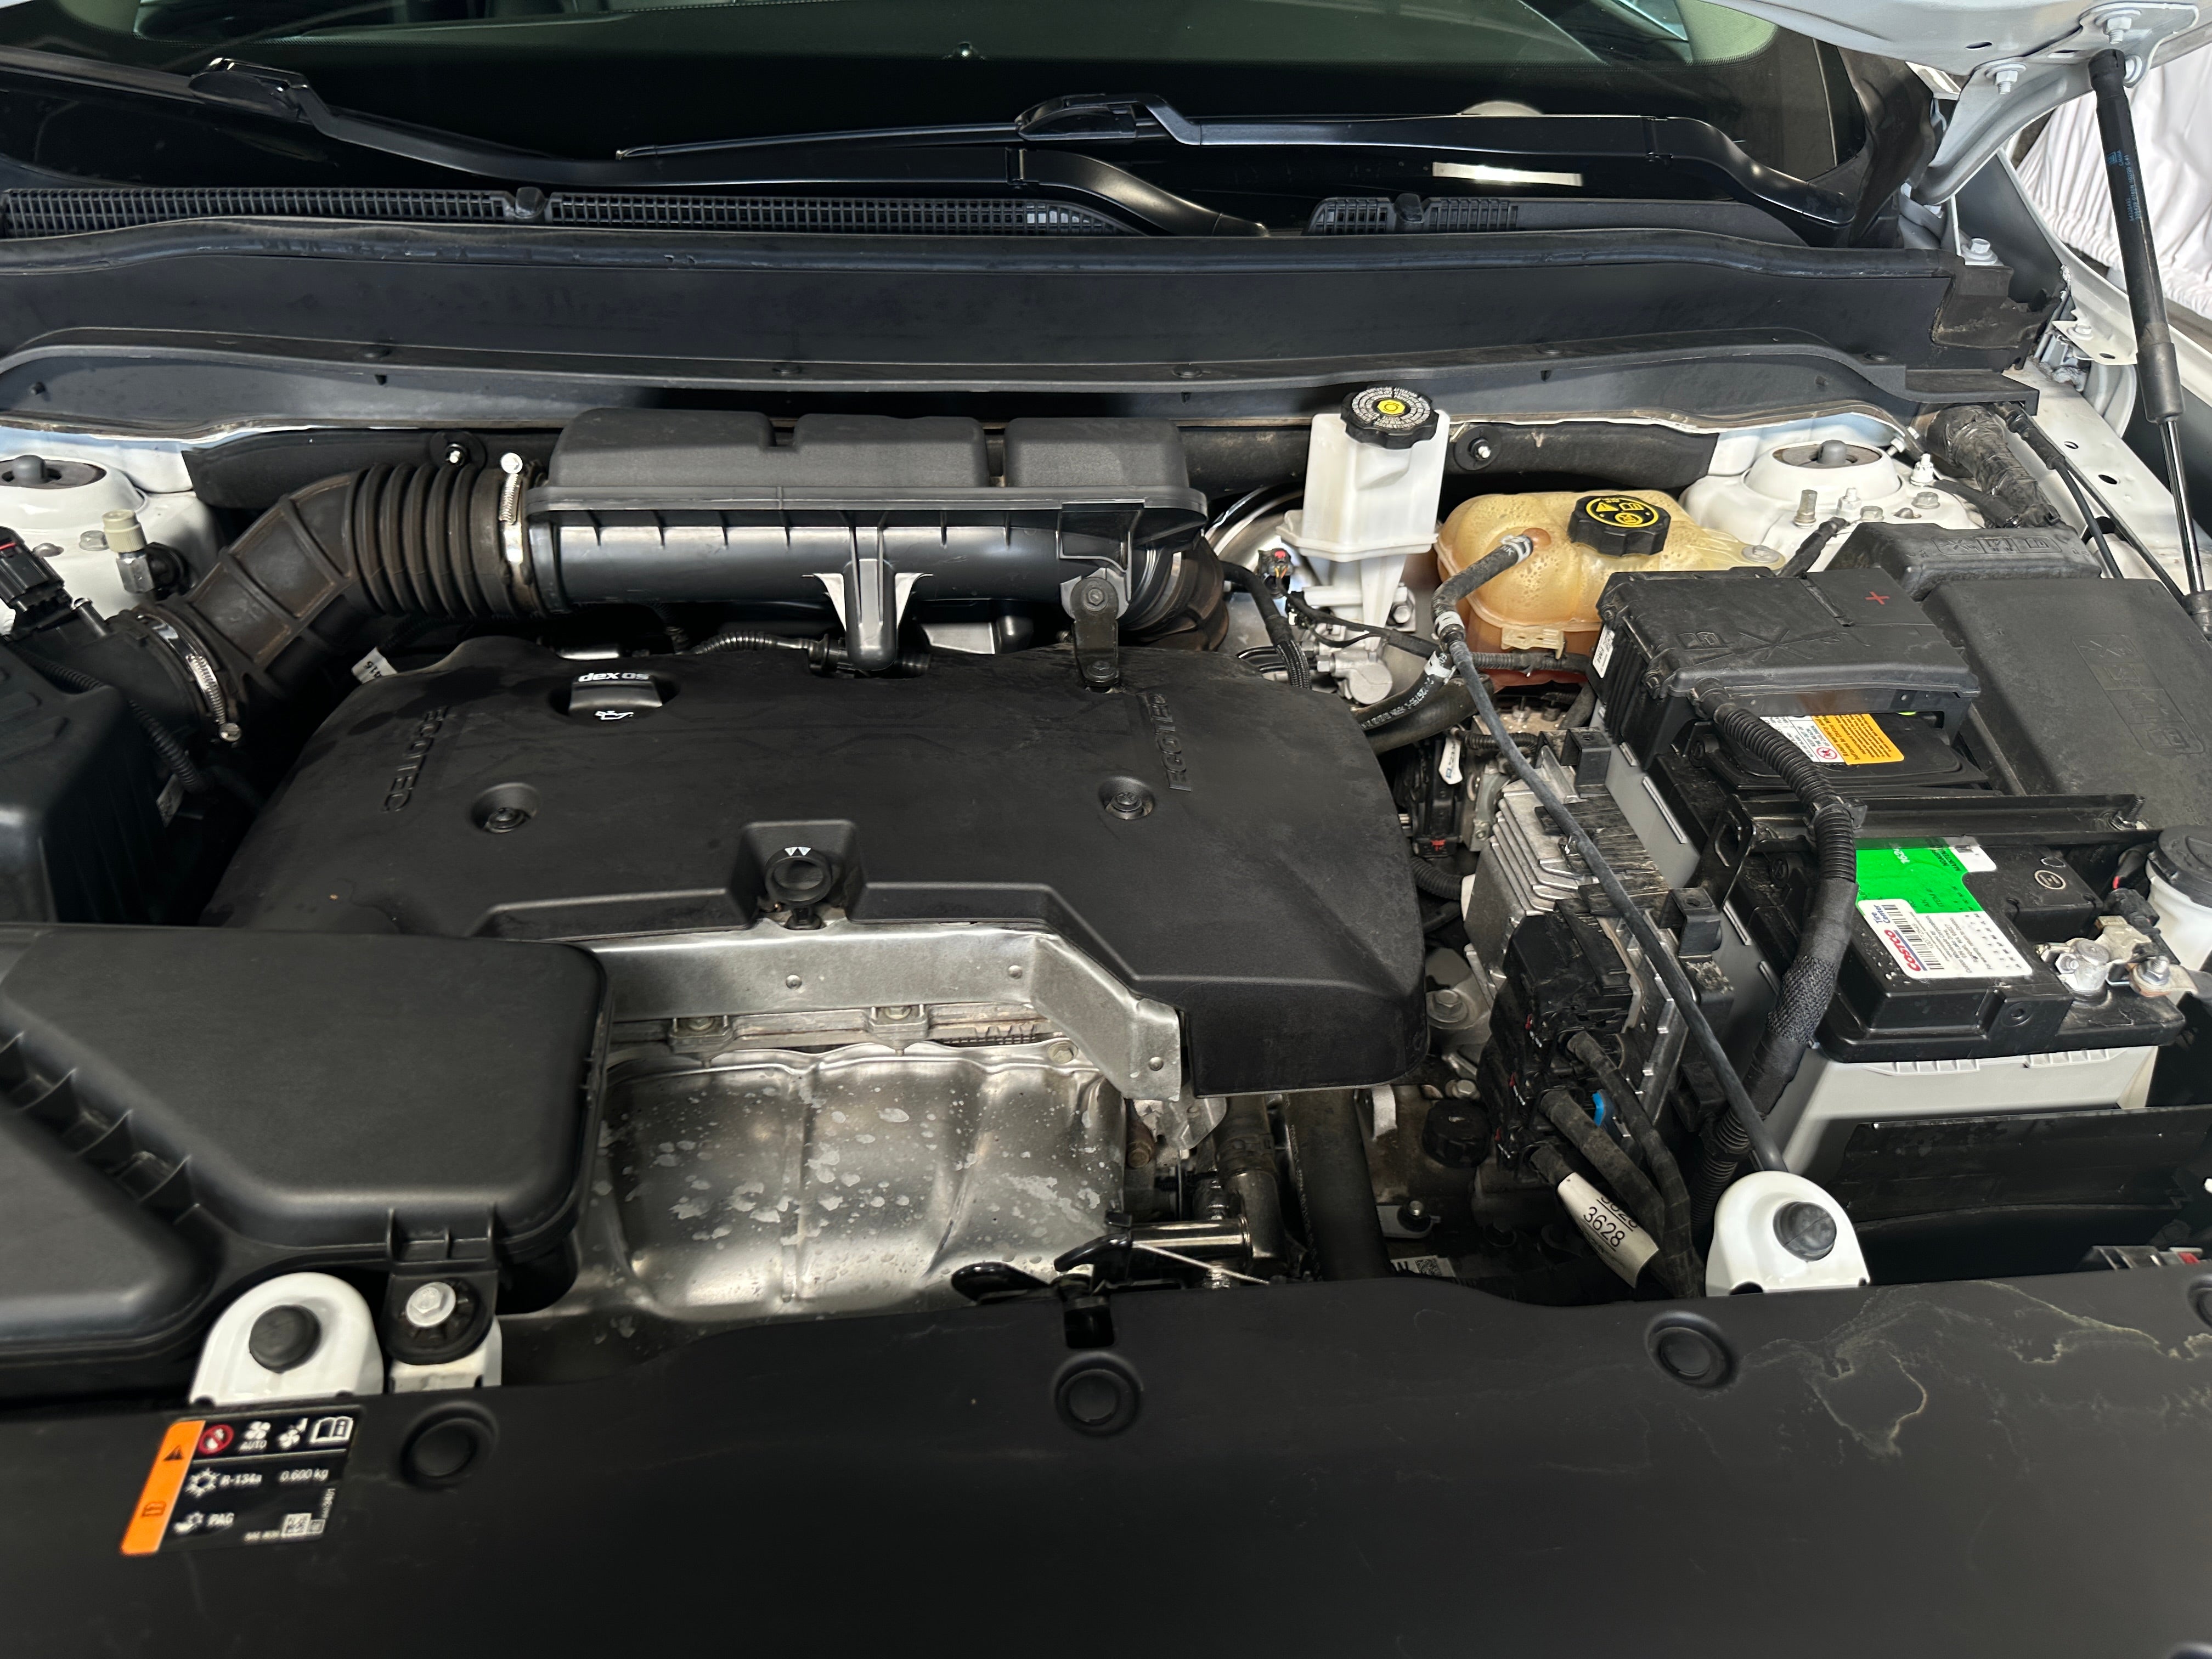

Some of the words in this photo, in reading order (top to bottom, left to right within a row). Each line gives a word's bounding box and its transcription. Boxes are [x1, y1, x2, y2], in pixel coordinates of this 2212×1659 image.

[1822, 727, 1838, 743] warranty
[1829, 724, 1842, 738] Costco
[1148, 692, 1192, 792] ECOTEC
[1836, 744, 1849, 756] Return
[1843, 743, 1860, 760] batteries
[383, 706, 450, 814] ECOTEC
[1929, 893, 1944, 907] ITEM
[1871, 912, 1882, 923] Tire
[1874, 905, 1891, 923] Center
[1884, 929, 1921, 971] COSTCO
[1943, 939, 1960, 958] Wholesale
[1951, 940, 1961, 950] Lake
[1959, 960, 1972, 973] Costco
[1583, 1206, 1625, 1247] 3628
[238, 1440, 268, 1452] AUTO
[219, 1473, 262, 1485] R-134a
[278, 1470, 312, 1483] 0.600
[313, 1469, 329, 1482] kg
[207, 1513, 234, 1527] PAG
